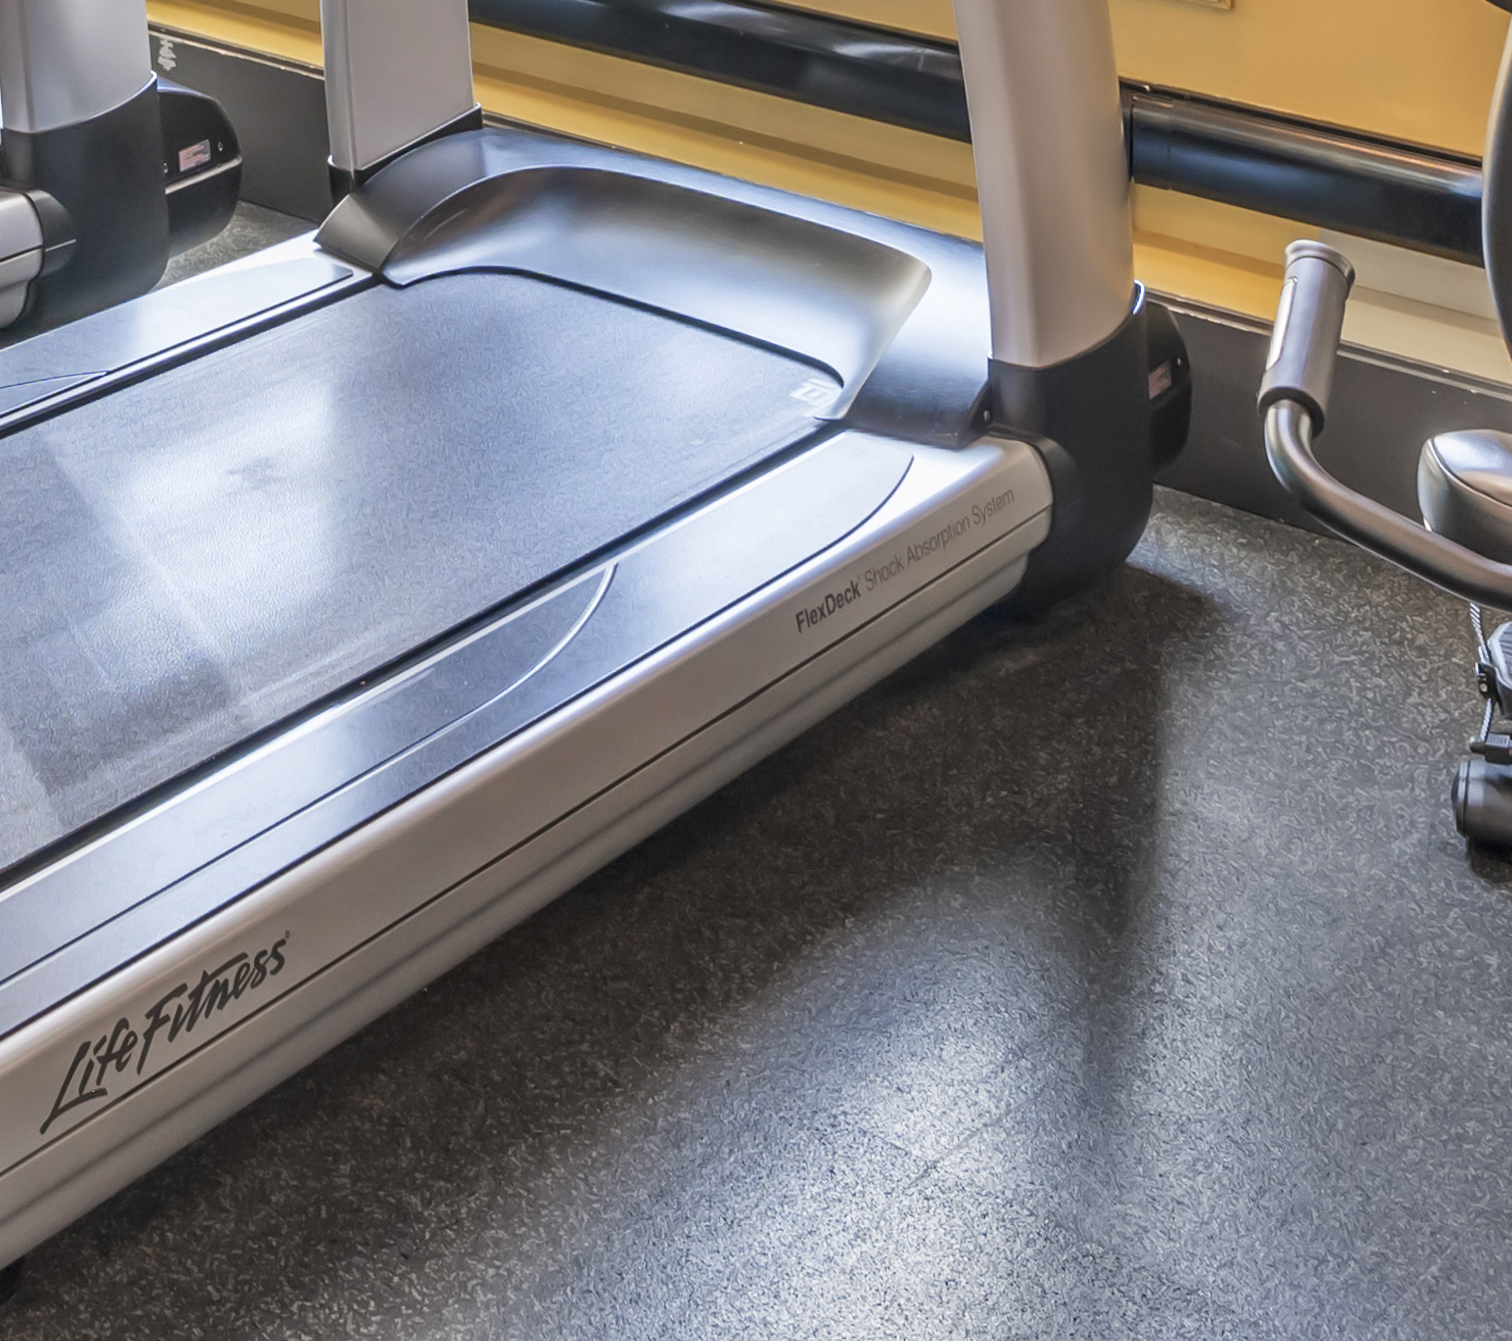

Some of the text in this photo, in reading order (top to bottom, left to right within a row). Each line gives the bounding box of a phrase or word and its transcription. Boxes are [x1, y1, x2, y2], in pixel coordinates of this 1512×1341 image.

[795, 488, 1016, 634] FlexDeck Shock Absorption System
[39, 929, 291, 1136] Life Fitness
